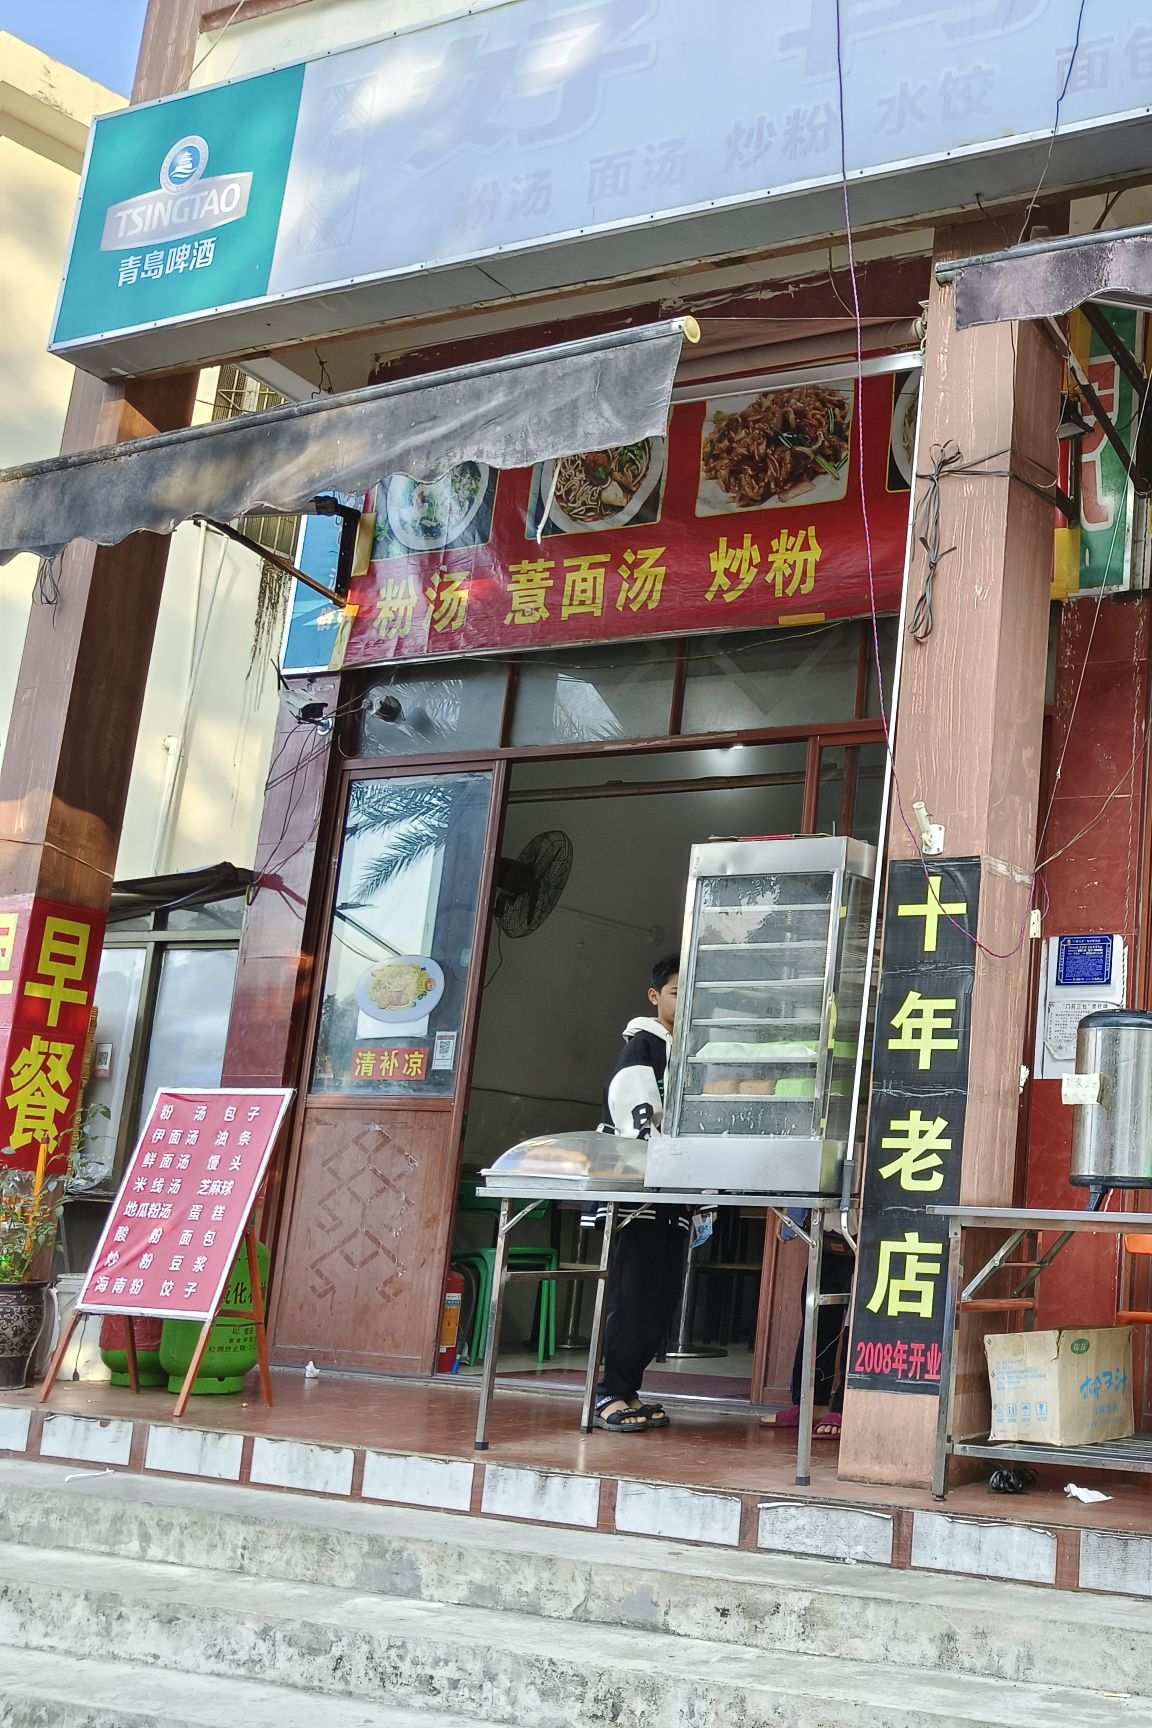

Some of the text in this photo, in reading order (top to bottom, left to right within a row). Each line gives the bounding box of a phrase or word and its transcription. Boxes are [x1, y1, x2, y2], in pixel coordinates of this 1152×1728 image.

[587, 138, 689, 201] 面汤
[723, 101, 841, 173] 炒粉
[874, 64, 995, 137] 水饺
[115, 183, 241, 238] TSINGTAO
[373, 565, 470, 641] 粉汤
[703, 525, 823, 603] 炒粉
[5, 915, 91, 1154] 早餐
[354, 1050, 425, 1077] 清补凉
[867, 875, 967, 1319] 十年老店
[159, 1104, 261, 1122] 粉汤 包子
[151, 1127, 252, 1147] 伊面汤 油条
[206, 1154, 242, 1172] 馒头
[132, 1176, 235, 1196] 米线汤 芝麻球
[123, 1201, 226, 1222] 地瓜粉汤 蛋糕
[178, 1229, 216, 1247] 面包
[103, 1250, 208, 1273] 炒粉 豆浆
[94, 1275, 198, 1299] 海南粉 饺子
[854, 1339, 942, 1380] 2008年开业
